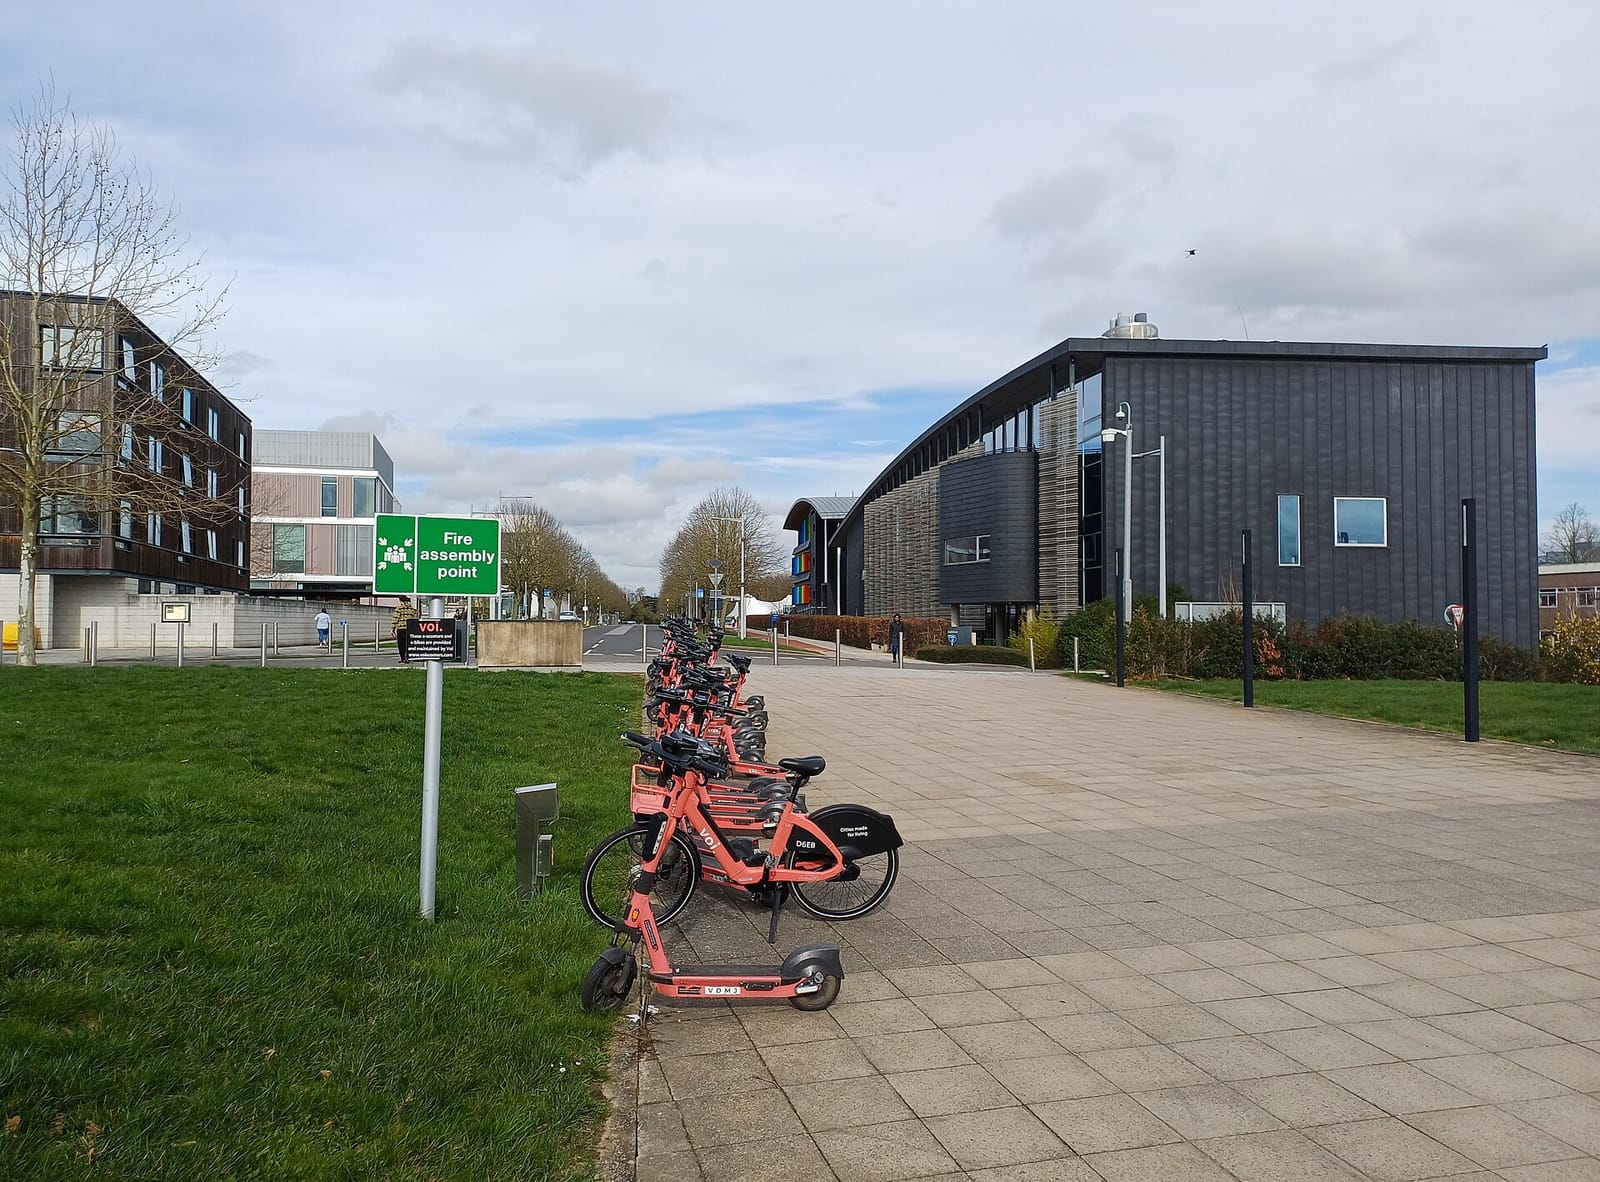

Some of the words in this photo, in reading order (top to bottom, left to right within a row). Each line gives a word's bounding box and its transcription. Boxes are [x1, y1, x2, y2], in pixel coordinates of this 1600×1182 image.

[444, 532, 472, 545] Fire
[420, 550, 495, 565] assembly
[438, 566, 477, 579] point
[796, 840, 816, 849] D6EB
